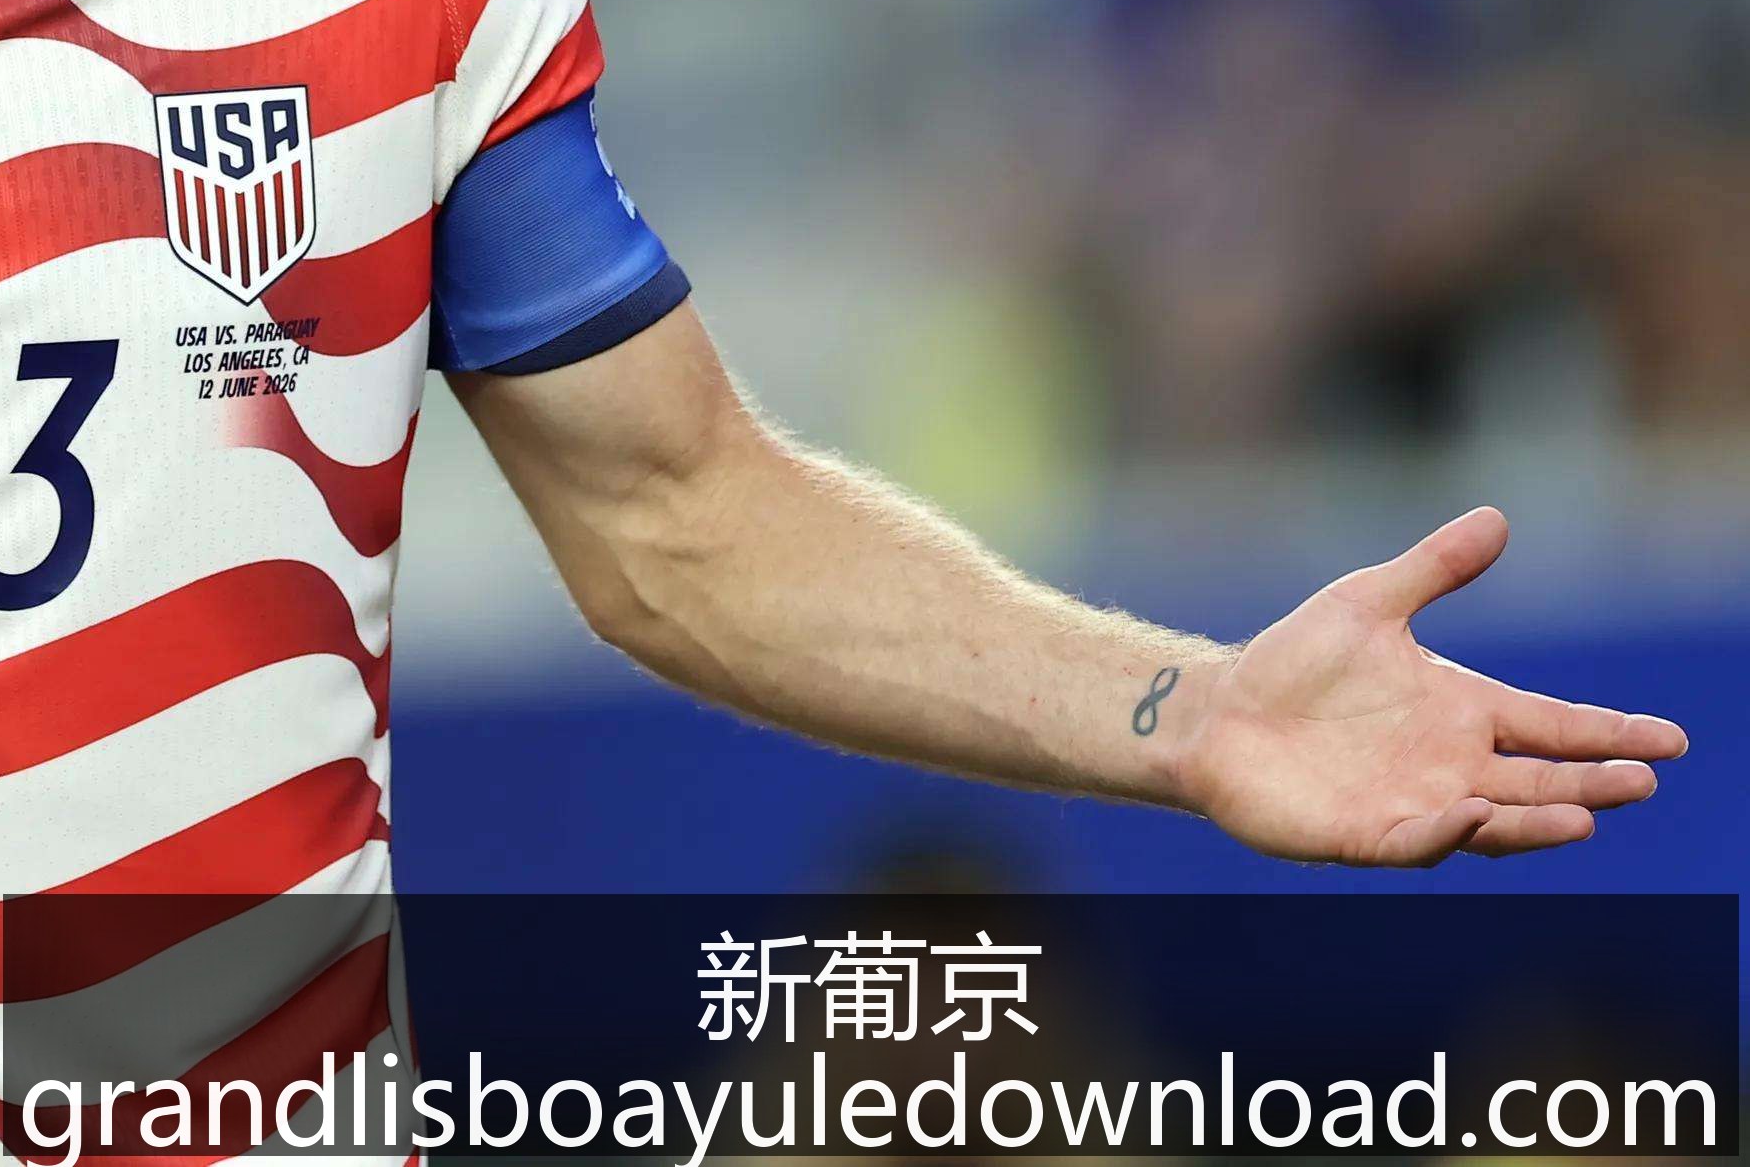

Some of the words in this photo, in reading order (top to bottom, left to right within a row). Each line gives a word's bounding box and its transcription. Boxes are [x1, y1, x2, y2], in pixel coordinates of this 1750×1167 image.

[167, 99, 300, 180] USA
[176, 326, 207, 347] USA
[214, 325, 237, 345] VS.
[244, 317, 321, 343] PARAGUAY
[184, 353, 213, 373] LOS
[218, 347, 287, 371] ANGELES,
[293, 344, 310, 365] CA
[198, 379, 214, 399] 12
[218, 376, 259, 398] JUNE
[262, 372, 298, 395] 2026
